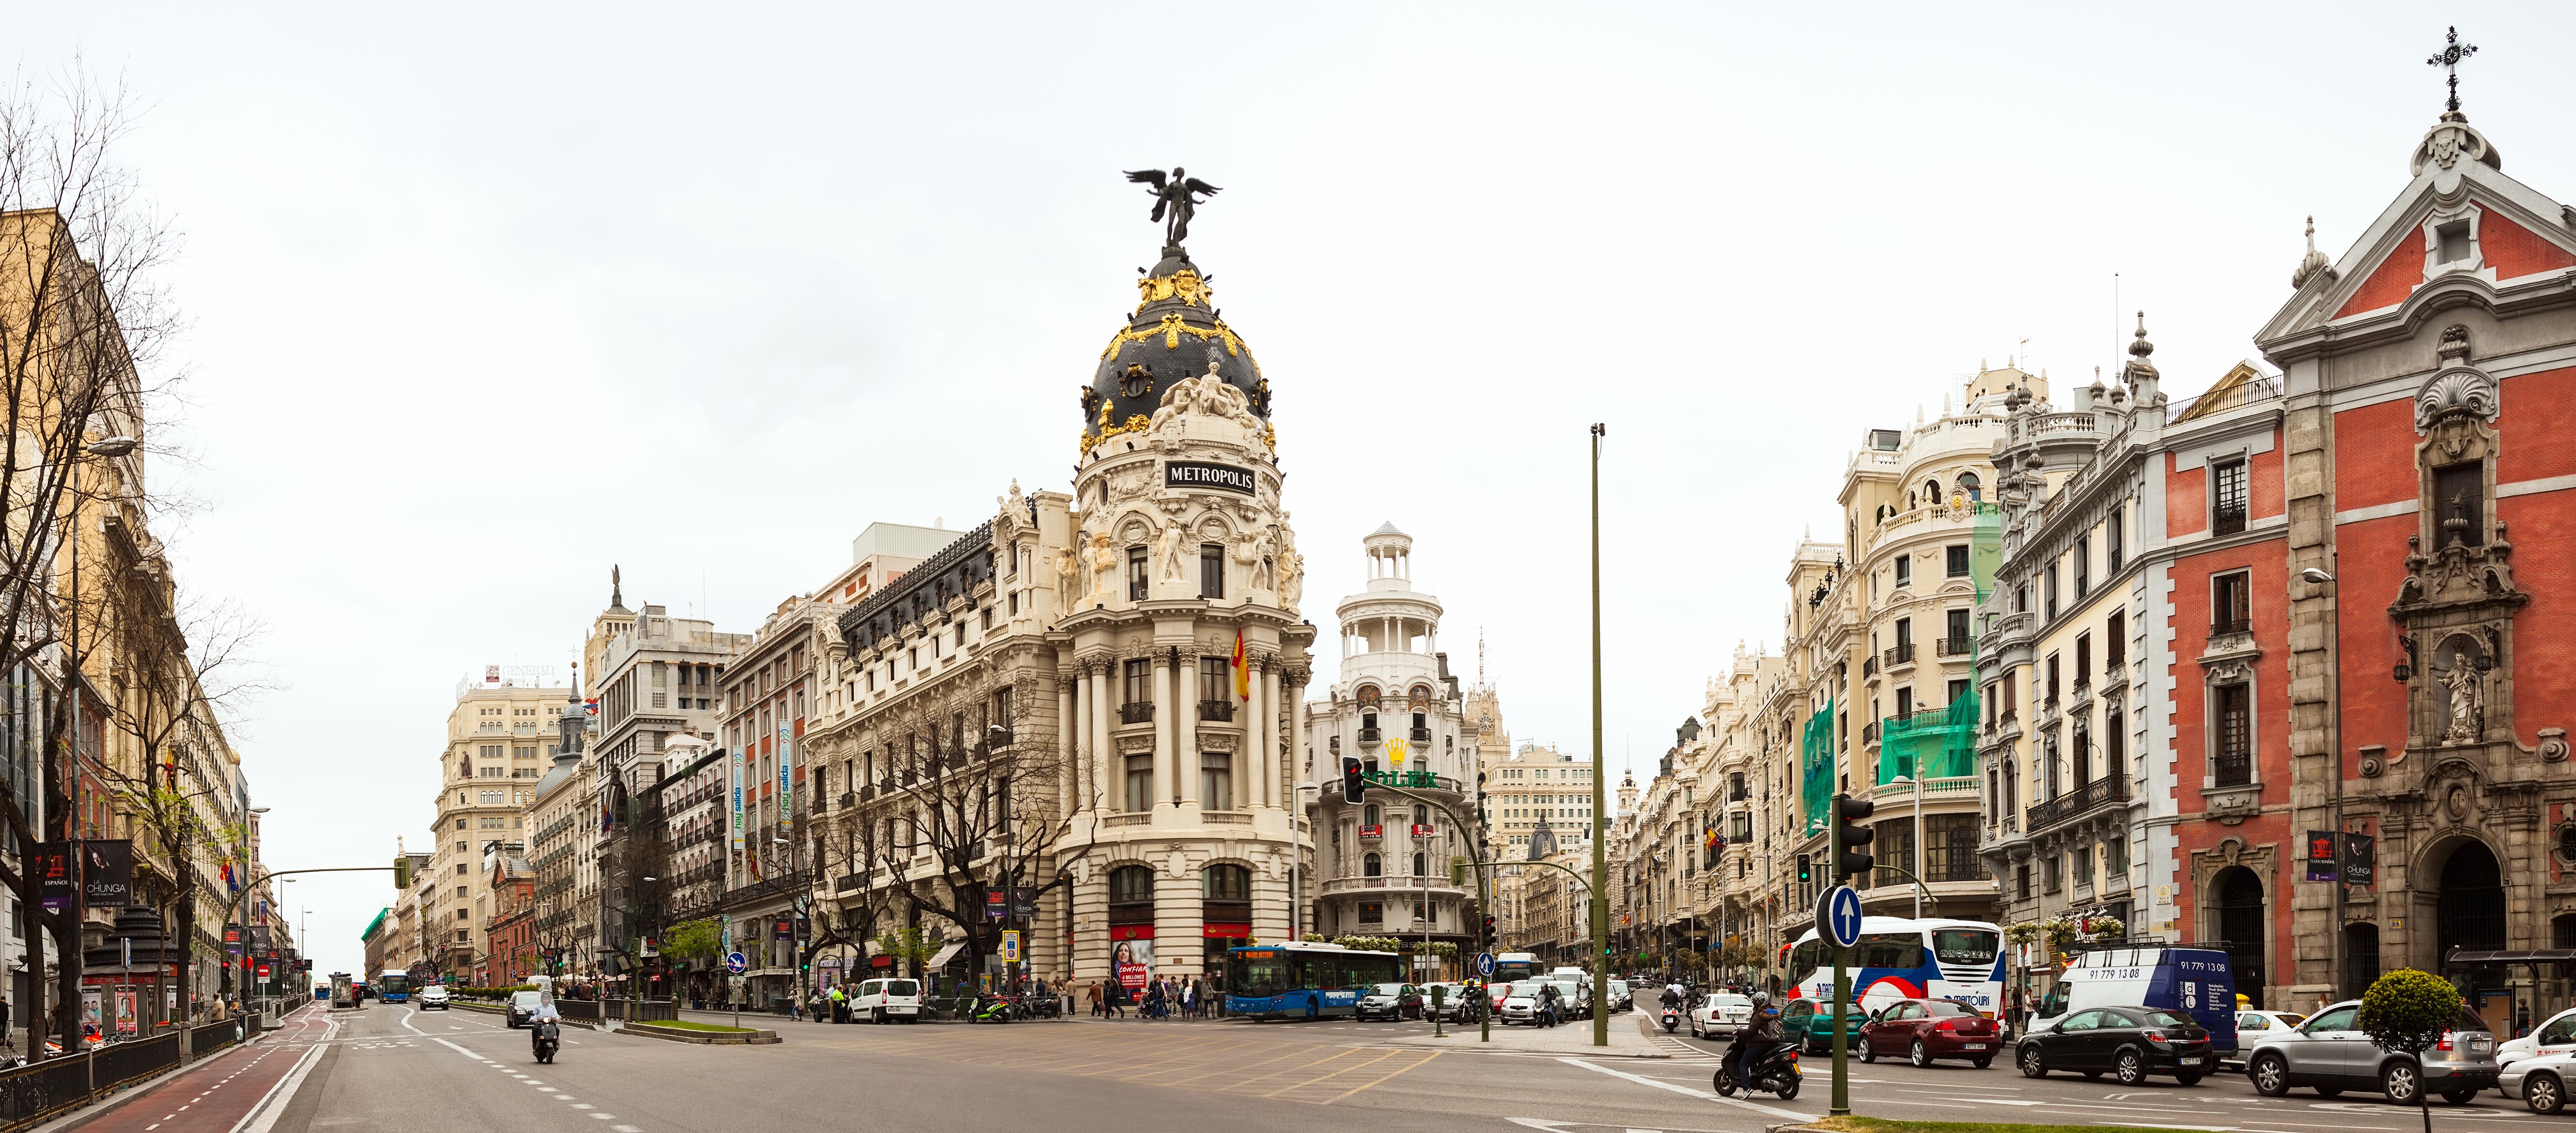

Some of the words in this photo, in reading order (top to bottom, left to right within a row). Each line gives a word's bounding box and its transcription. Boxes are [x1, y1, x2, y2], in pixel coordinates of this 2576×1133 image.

[1172, 467, 1252, 489] METROPOLIS
[503, 665, 554, 675] GENERALI
[781, 765, 789, 792] salida
[1362, 771, 1439, 788] ROLEX
[781, 793, 791, 810] hay
[734, 813, 743, 829] hay
[2347, 866, 2371, 874] CHUNGA
[87, 884, 126, 892] CHUNGA
[2181, 962, 2189, 970] 91
[2191, 962, 2205, 970] 779
[2207, 963, 2215, 971] 13
[2217, 964, 2225, 972] 08
[2090, 970, 2098, 979] 91
[2101, 969, 2115, 979] 779
[2119, 969, 2127, 978] 13
[2129, 969, 2140, 978] 08
[2187, 983, 2193, 994] d
[2189, 997, 2193, 1006] L
